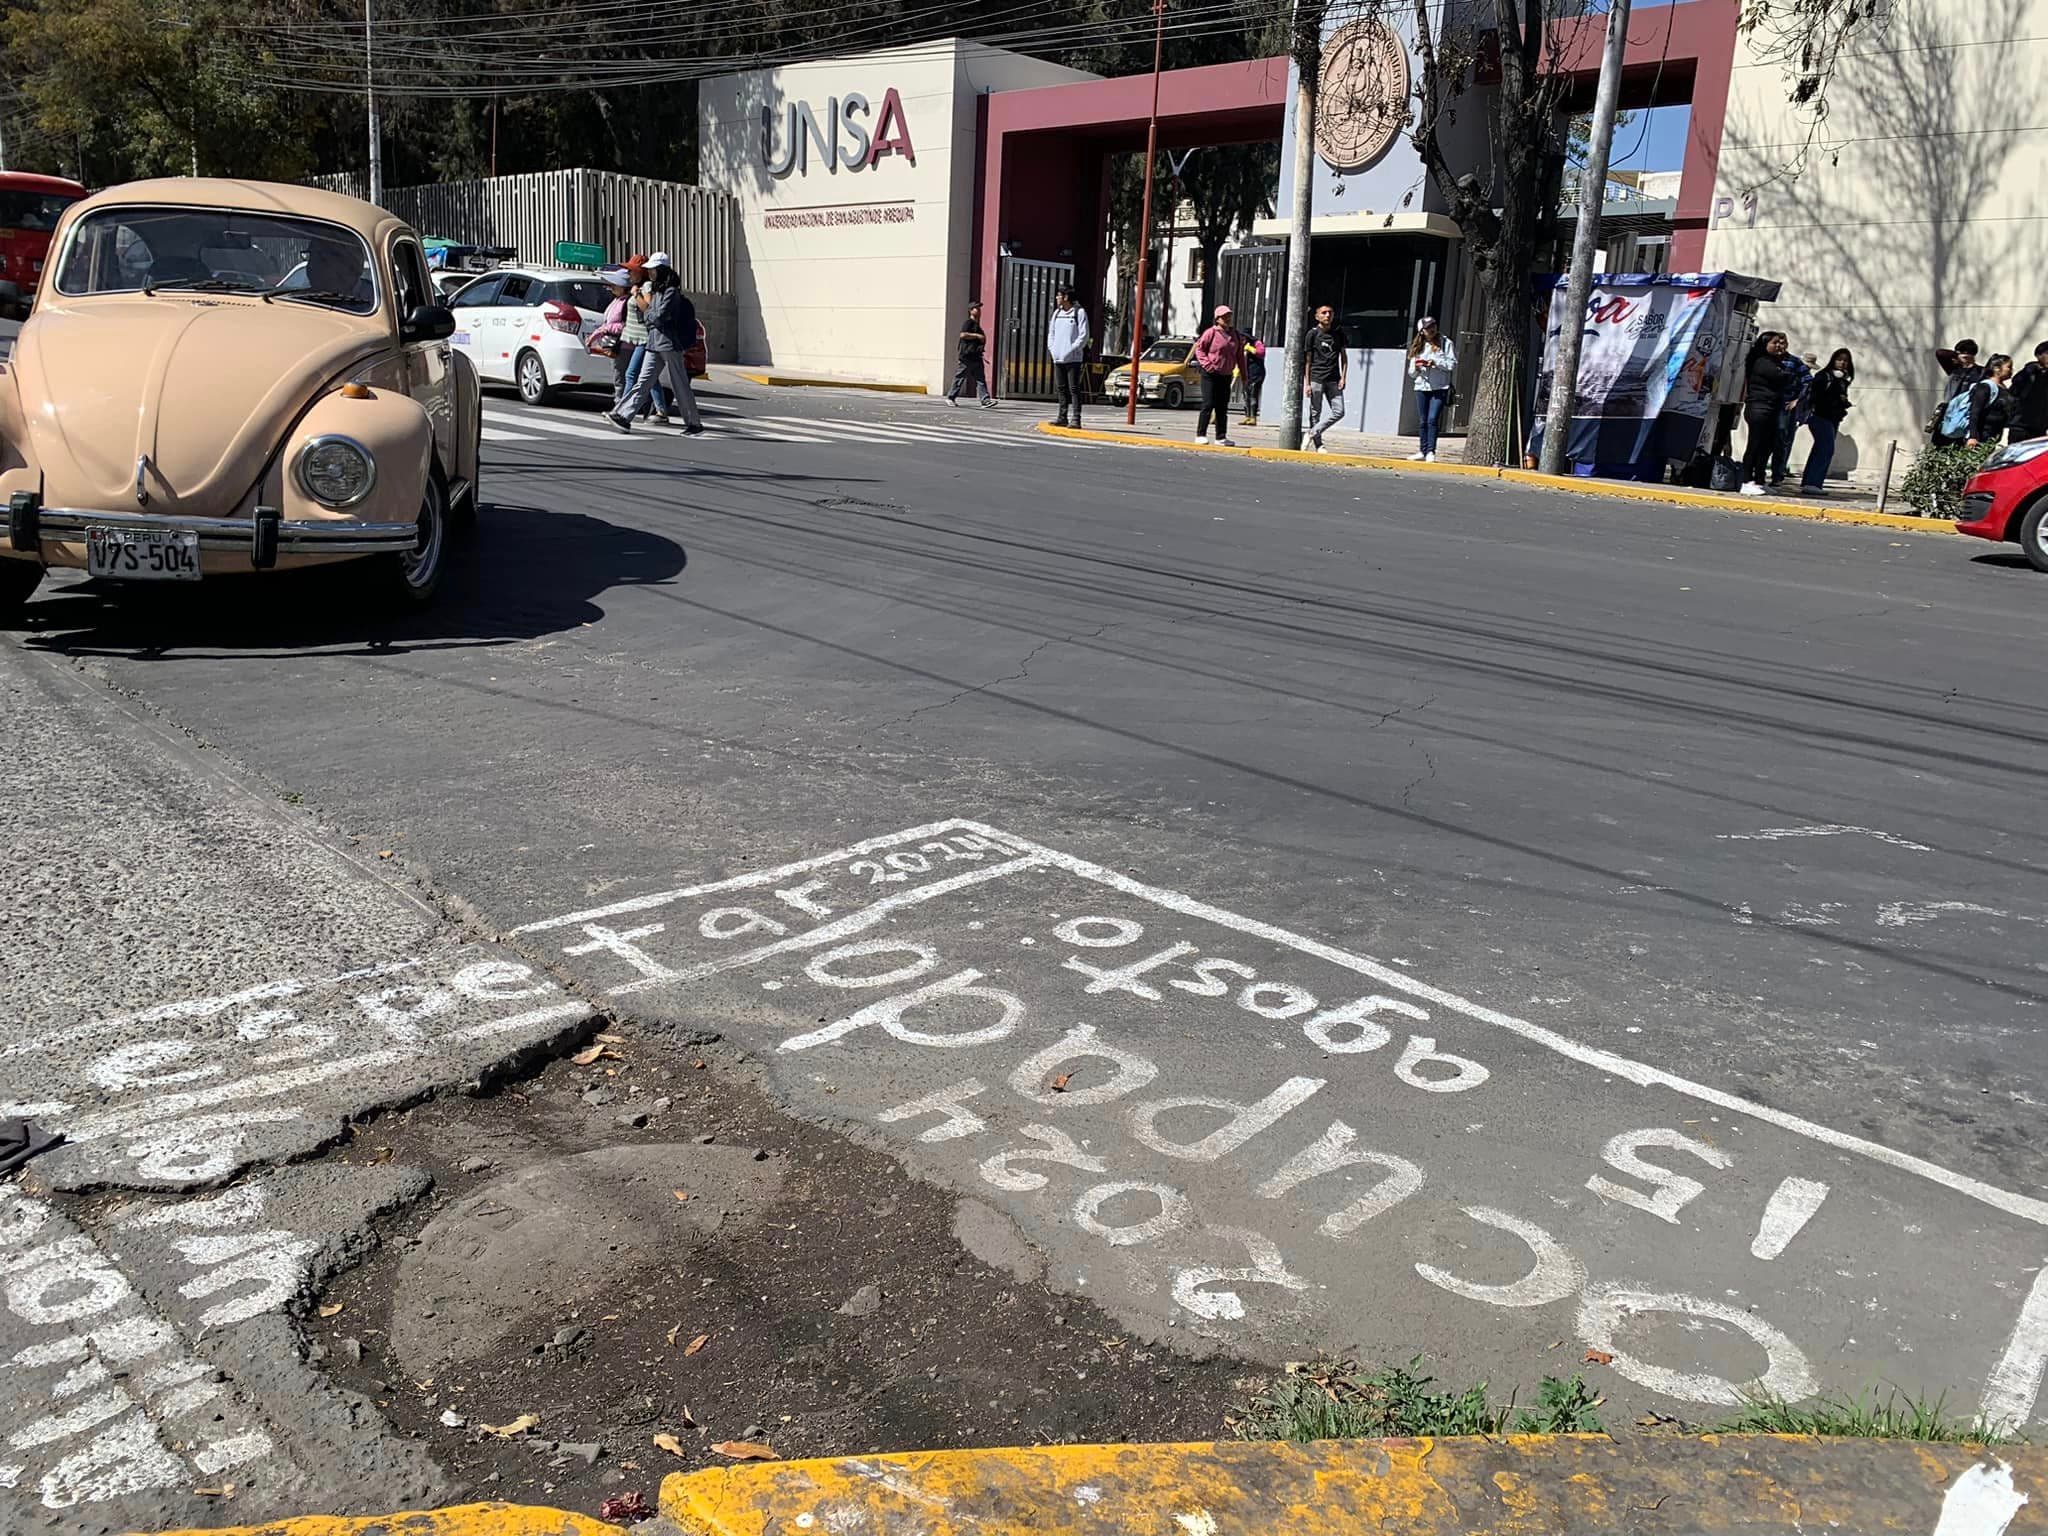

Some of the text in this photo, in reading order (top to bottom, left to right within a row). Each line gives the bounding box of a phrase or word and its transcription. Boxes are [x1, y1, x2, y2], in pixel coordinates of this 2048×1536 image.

[761, 88, 916, 179] UNSA
[1637, 314, 1664, 325] SABOR
[93, 541, 194, 572] V7S-504
[123, 532, 161, 543] PERU
[849, 833, 1019, 885] 2024
[1052, 915, 1831, 1260] 15 agosto
[877, 1077, 1312, 1322] 2024
